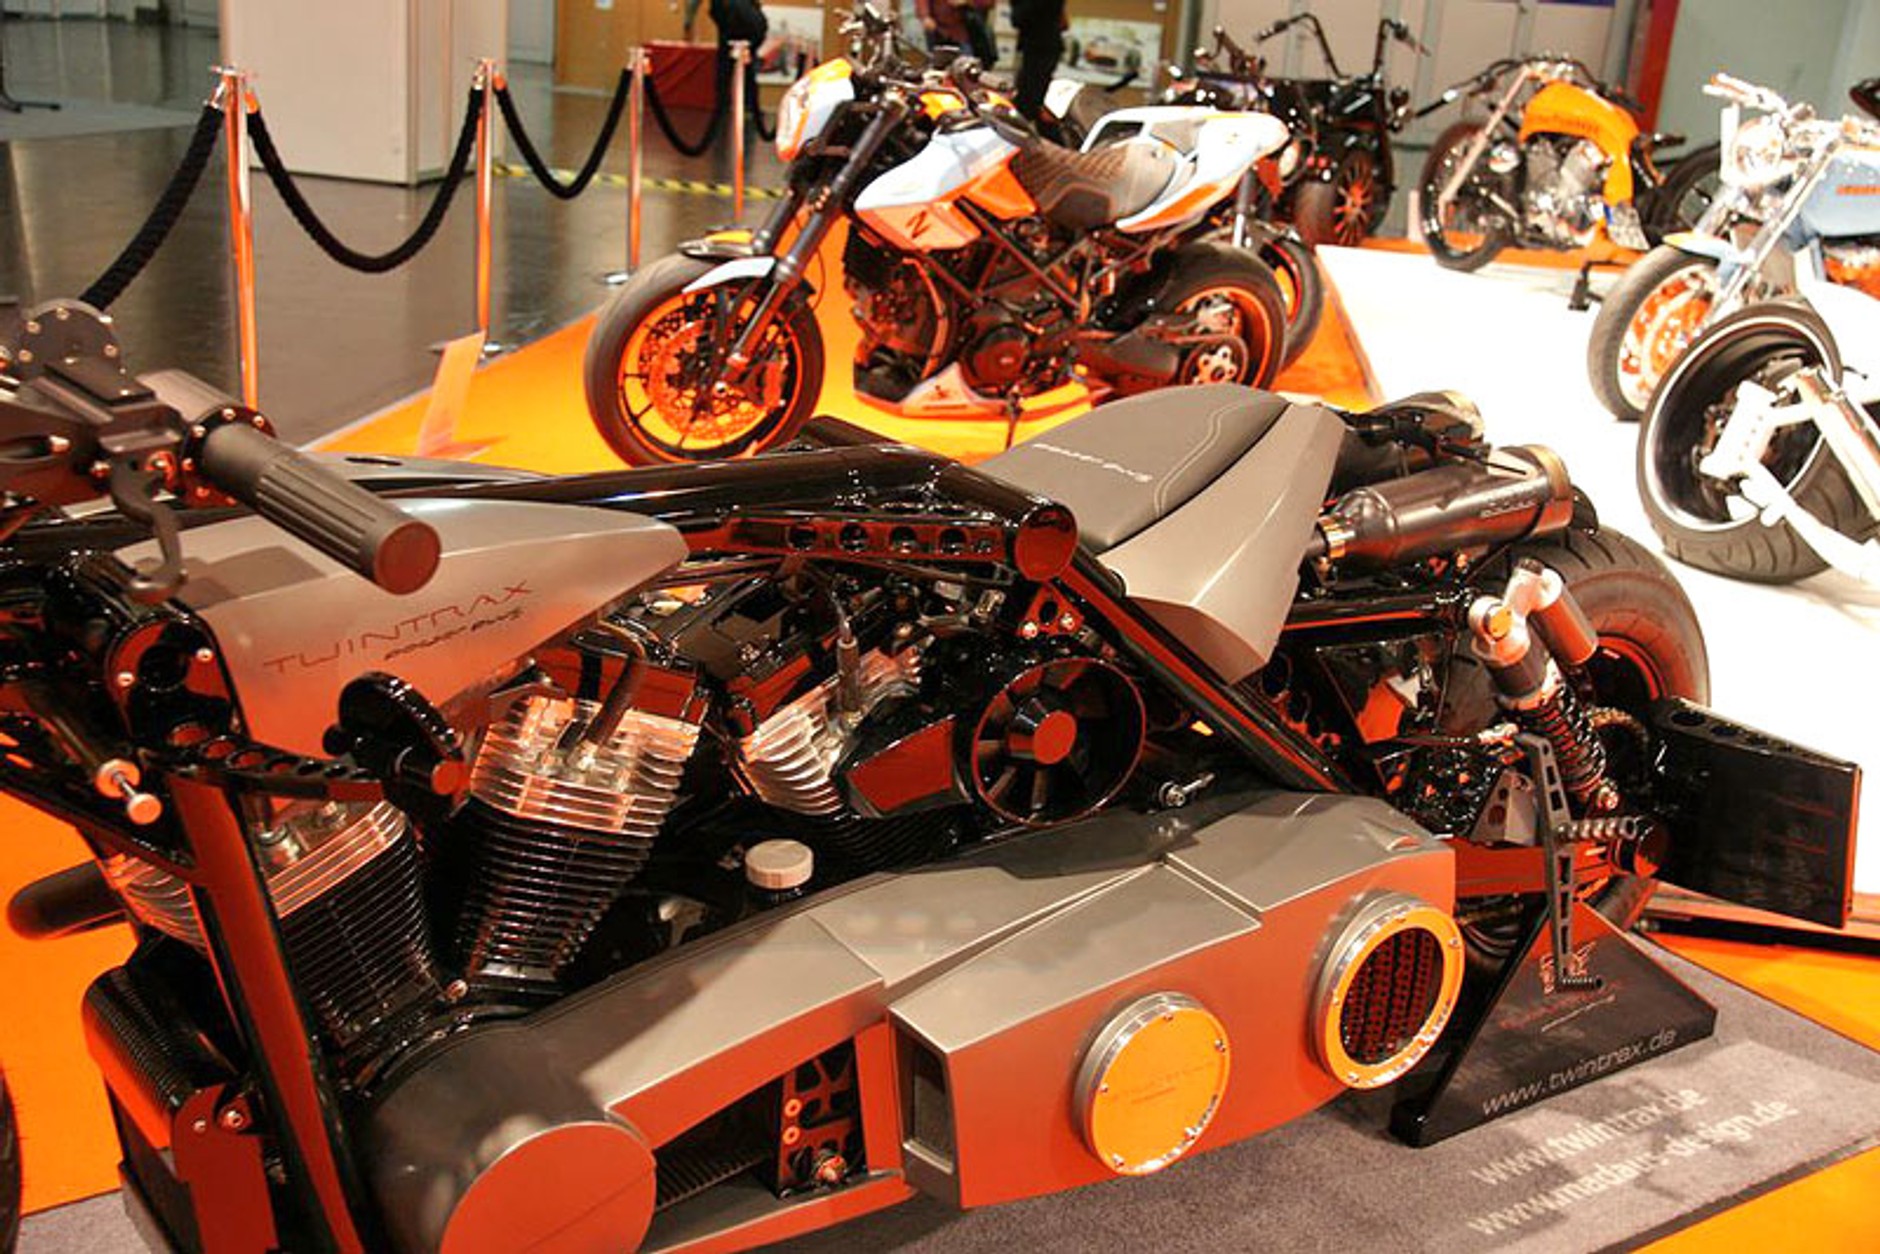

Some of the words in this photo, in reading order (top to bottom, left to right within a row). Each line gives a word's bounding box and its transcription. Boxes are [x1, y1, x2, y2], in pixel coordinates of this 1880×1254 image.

[263, 580, 533, 673] TWINTRAX
[1483, 1028, 1677, 1115] www.twintrax.de
[1471, 1086, 1706, 1187] www.twintrax.de
